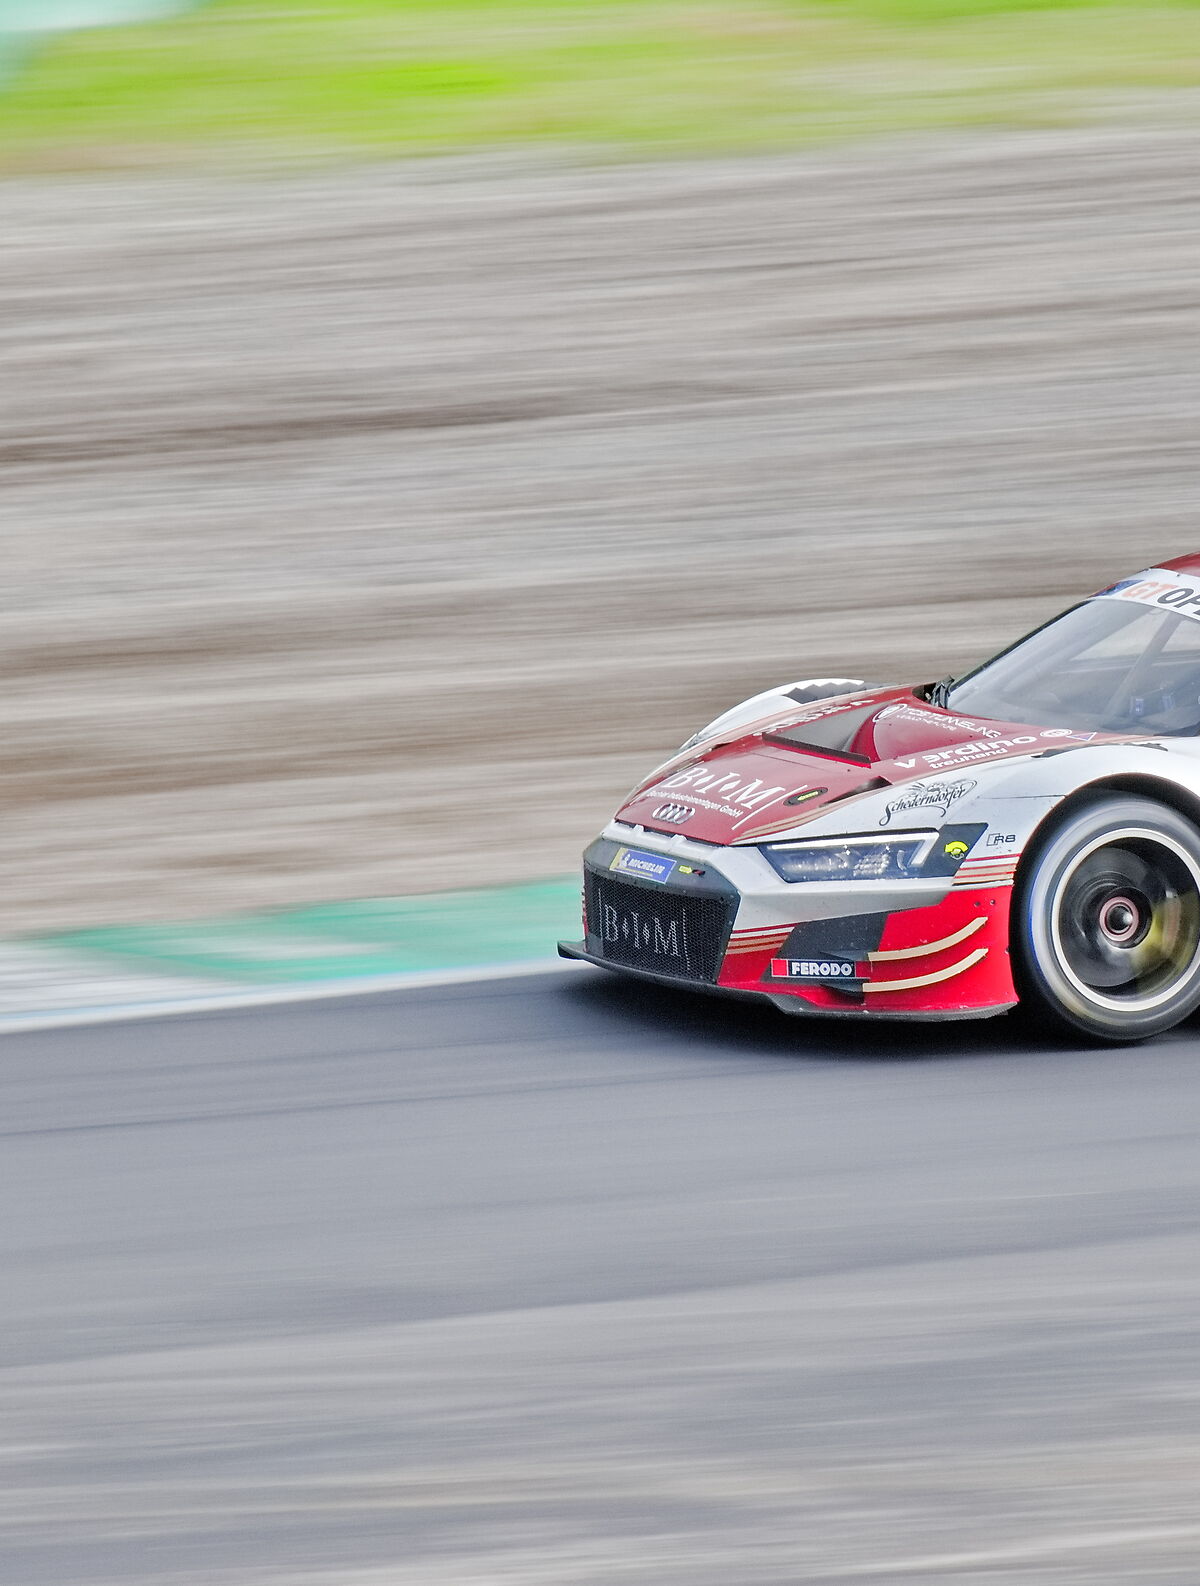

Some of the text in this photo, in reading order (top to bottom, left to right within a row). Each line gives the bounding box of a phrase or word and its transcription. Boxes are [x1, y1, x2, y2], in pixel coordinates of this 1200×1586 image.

[993, 834, 1016, 844] R8
[629, 857, 666, 875] MICHELIN
[791, 961, 854, 977] FERODO
